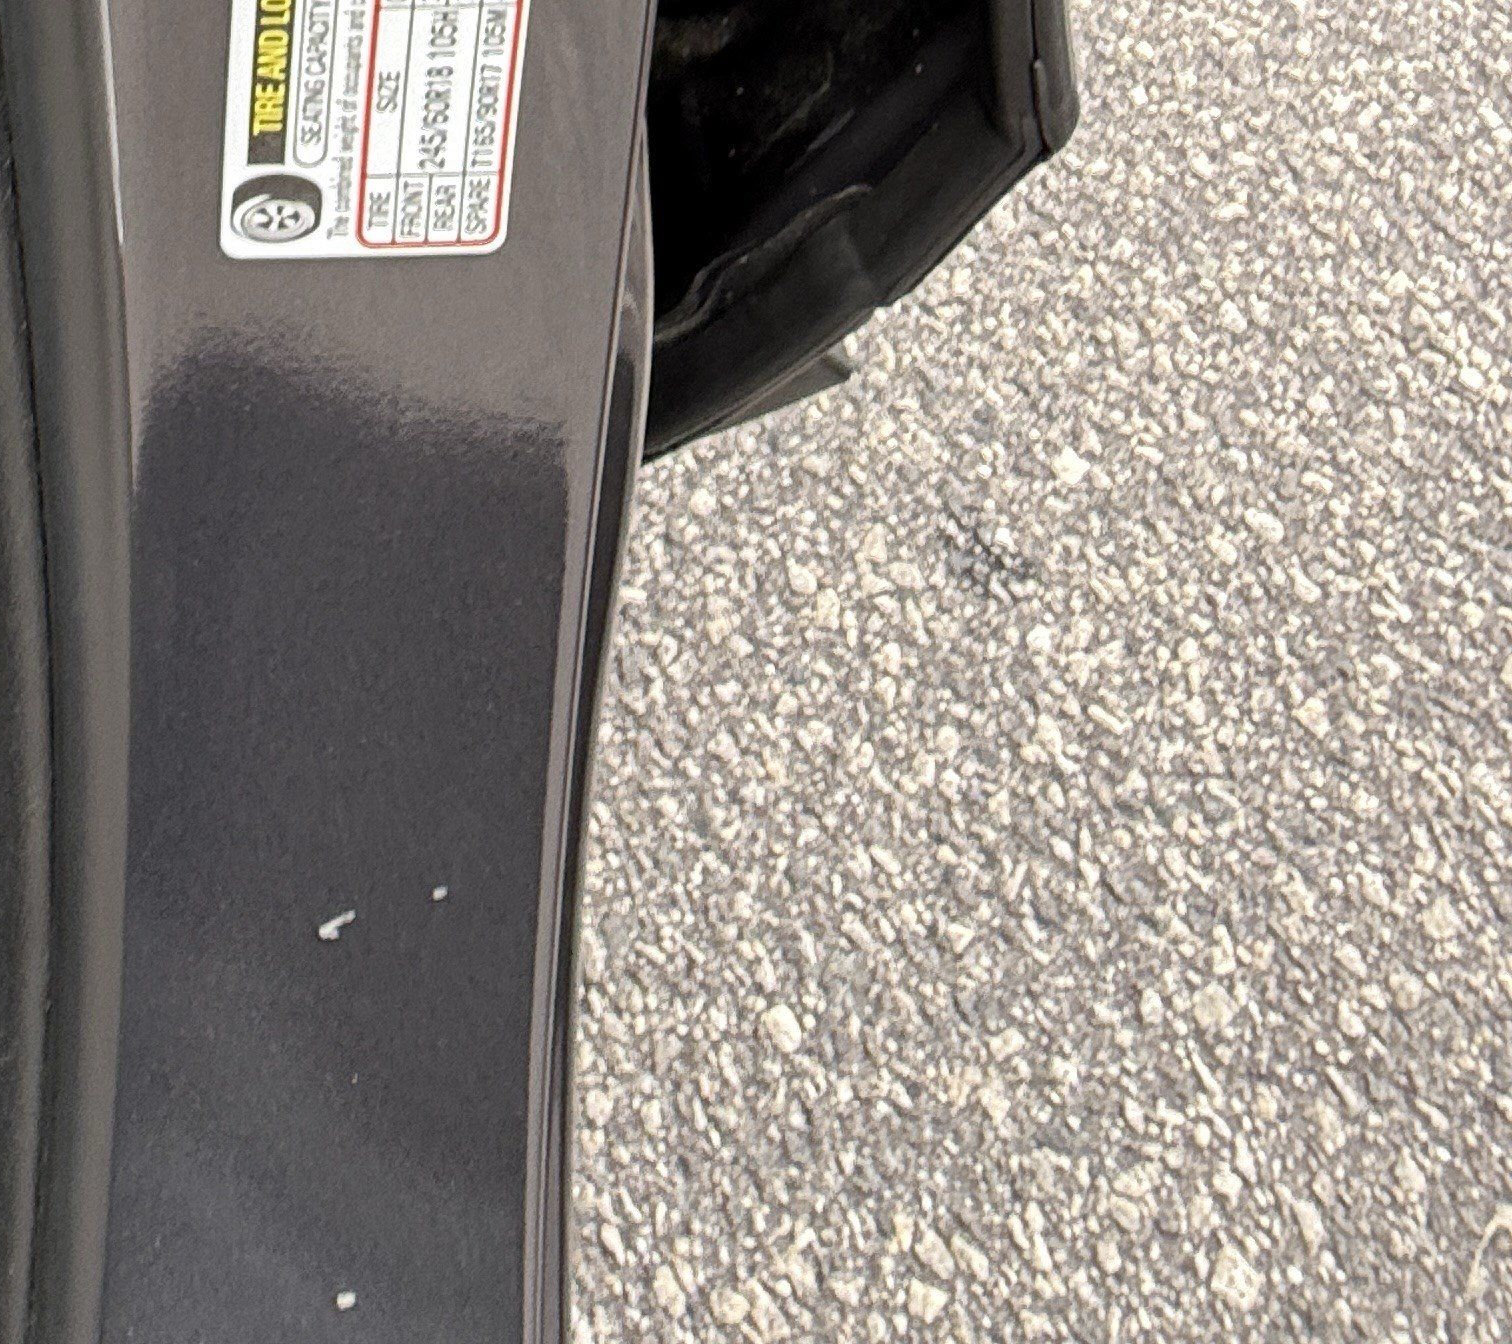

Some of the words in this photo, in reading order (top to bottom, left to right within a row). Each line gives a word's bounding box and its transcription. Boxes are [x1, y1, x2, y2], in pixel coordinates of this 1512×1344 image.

[256, 29, 289, 81] AND
[304, 0, 331, 76] CAPACITY
[426, 10, 459, 61] 105H
[252, 82, 286, 133] TIRE
[300, 79, 326, 145] SEATING
[375, 70, 401, 114] SIZE
[418, 65, 454, 170] 245/60R18
[366, 191, 391, 231] TIRE
[400, 180, 424, 238] FRONT
[432, 184, 456, 232] REAR
[464, 177, 491, 235] SPARE
